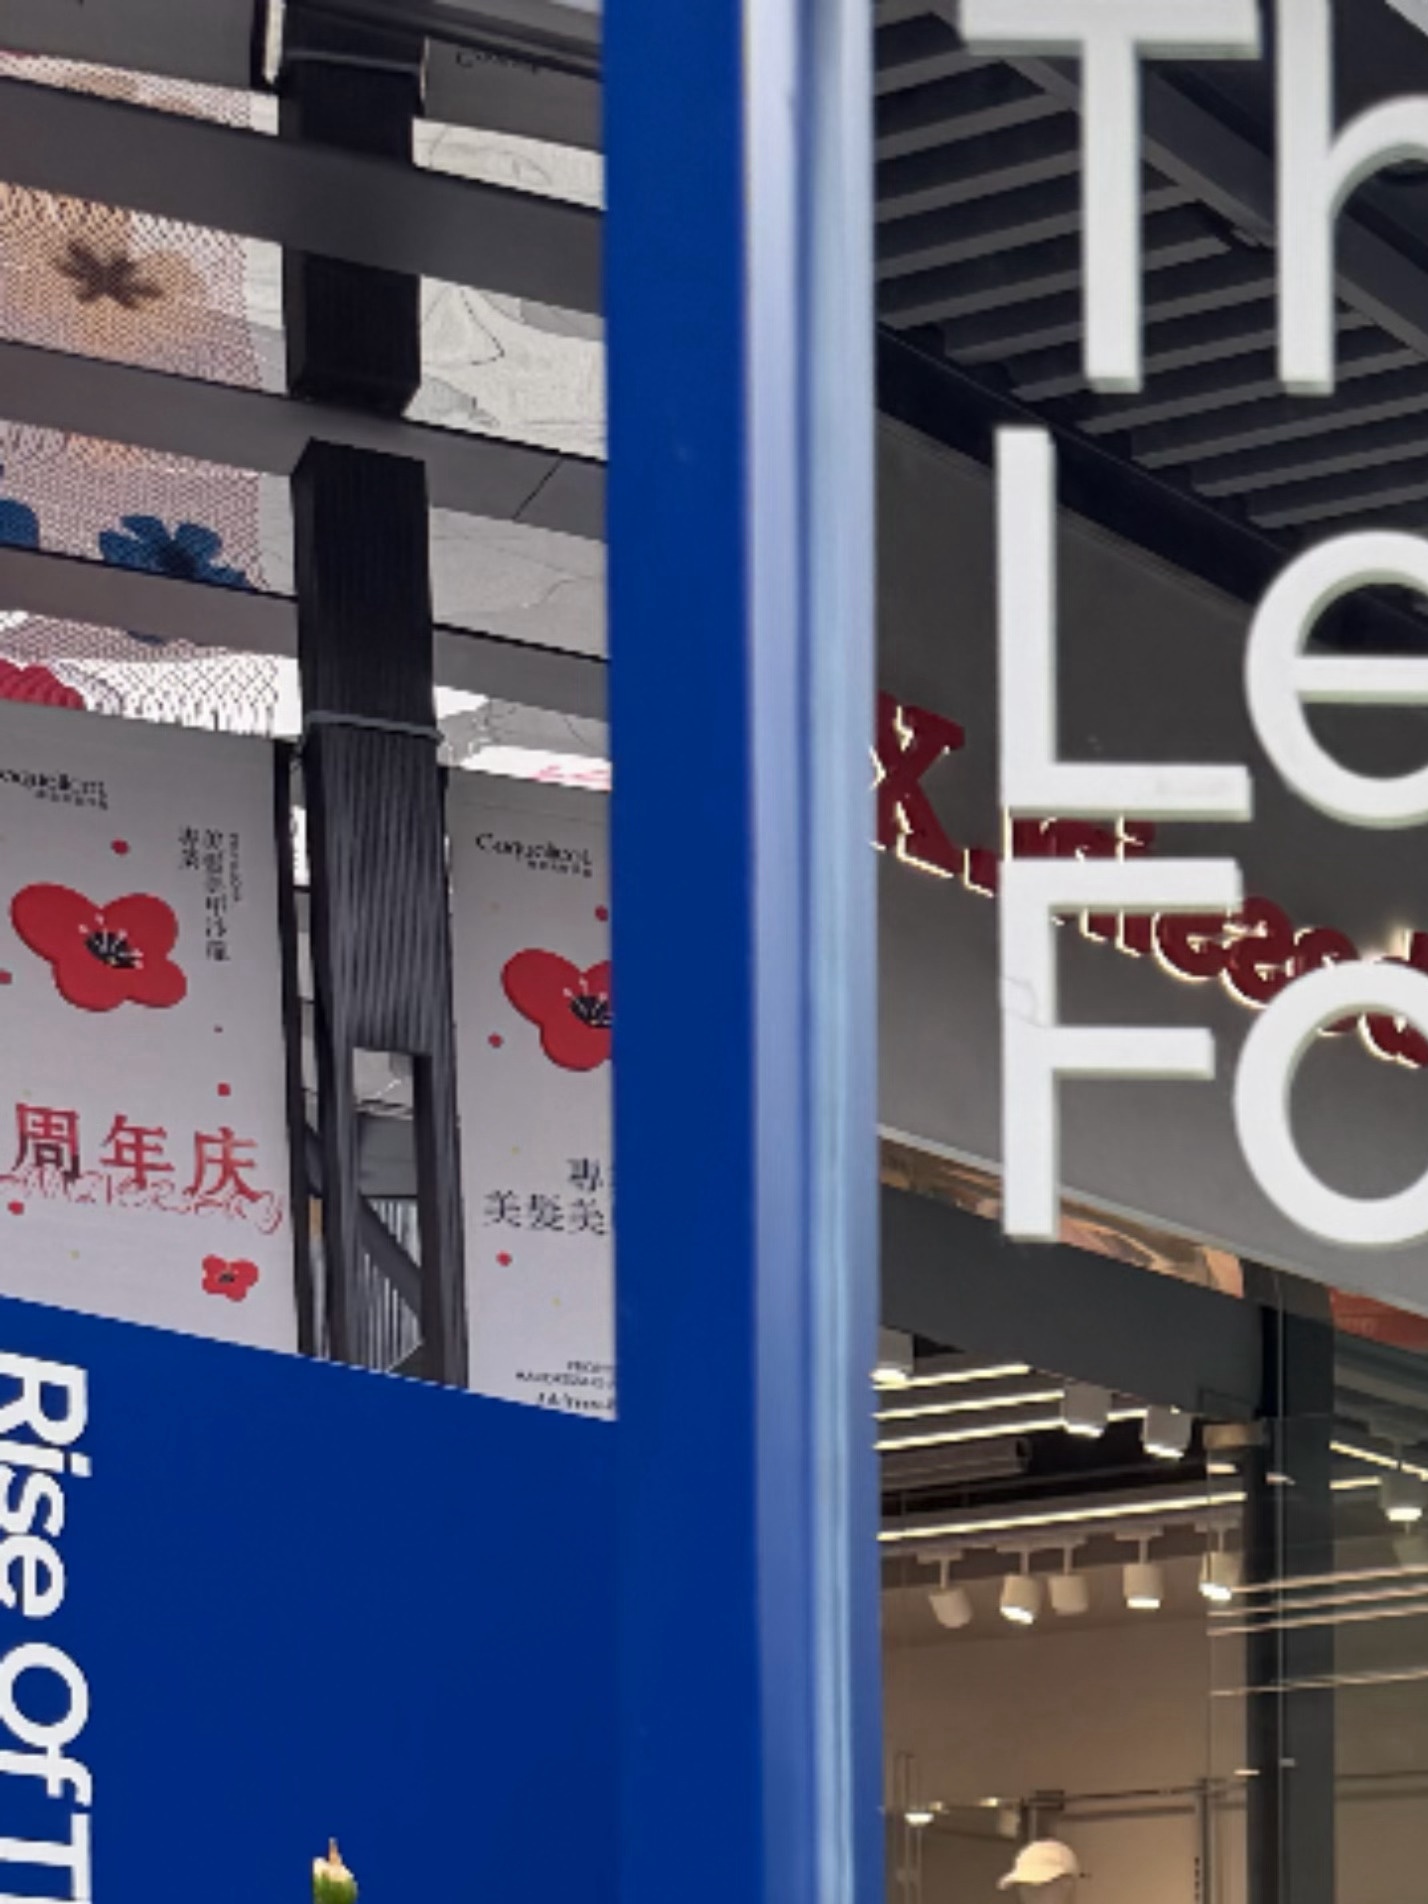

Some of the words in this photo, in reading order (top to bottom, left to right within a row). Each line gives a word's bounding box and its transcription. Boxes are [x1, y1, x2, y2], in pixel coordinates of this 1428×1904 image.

[12, 1103, 263, 1202] 周年庆
[0, 1351, 92, 1618] Rise
[0, 1642, 93, 1808] Of
